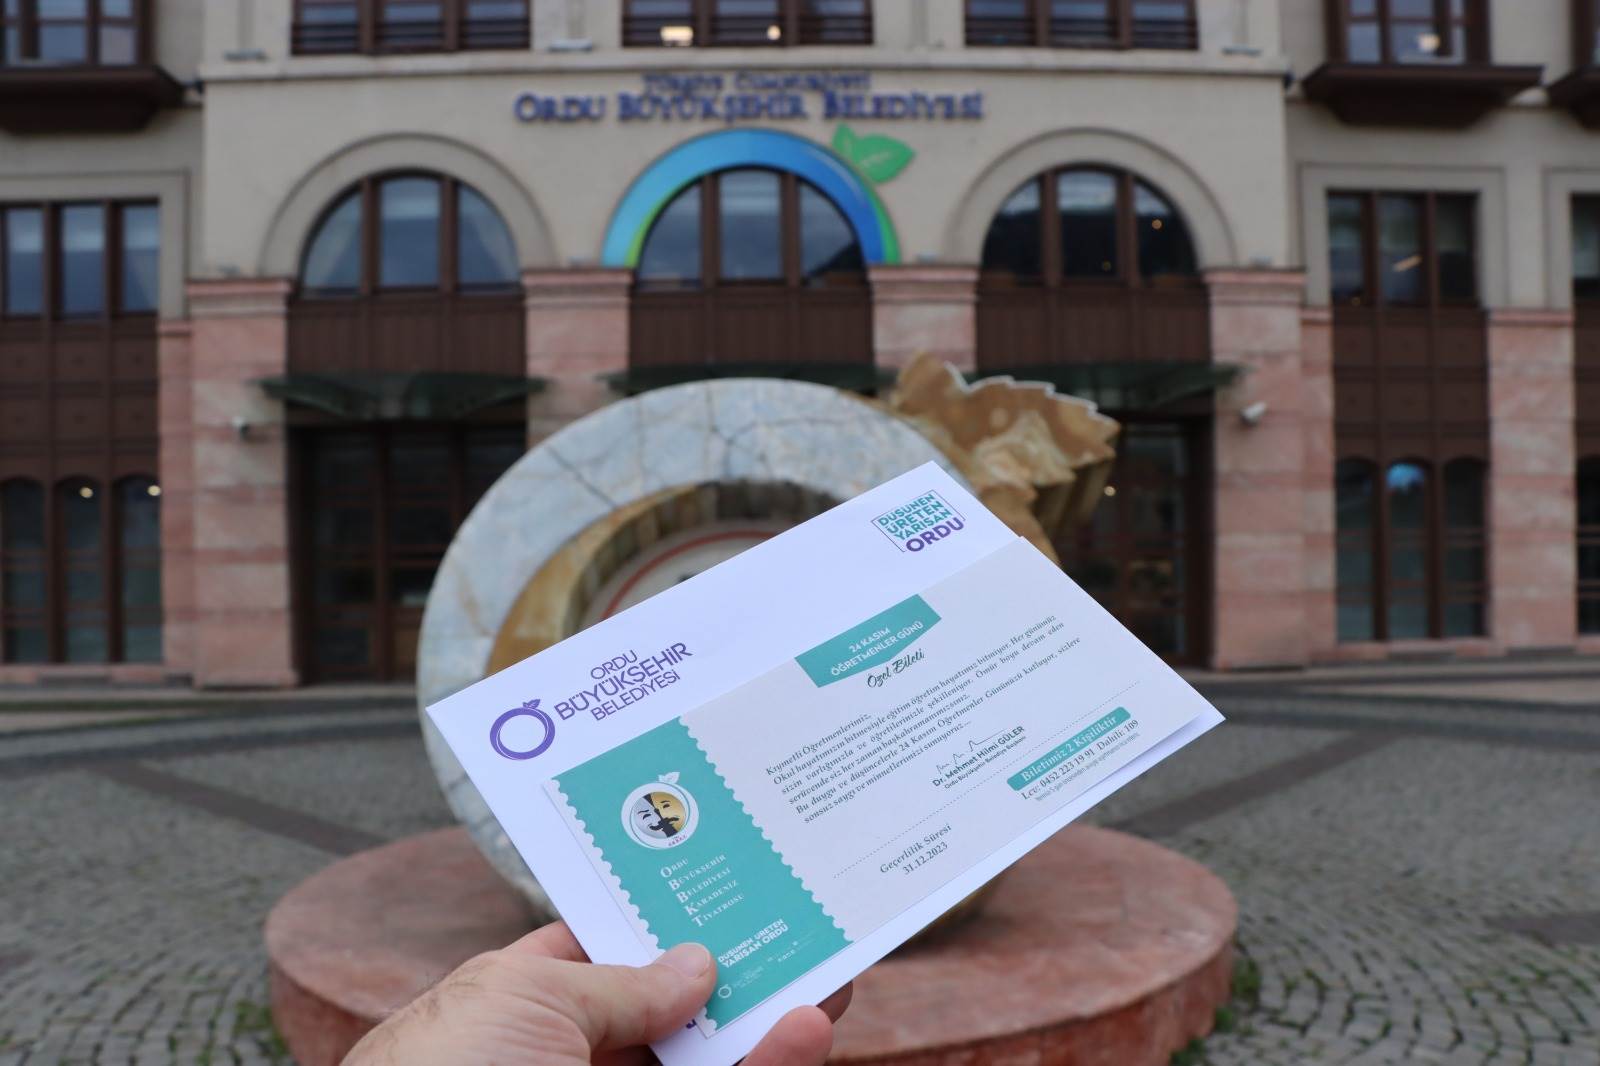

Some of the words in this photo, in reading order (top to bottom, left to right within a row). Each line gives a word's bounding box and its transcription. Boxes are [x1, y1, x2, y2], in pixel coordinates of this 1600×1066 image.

[514, 92, 605, 122] ORDU
[906, 518, 964, 552] ORDU
[831, 636, 898, 675] ÖĞRETMENLER
[897, 621, 923, 639] GÜNÜ
[849, 643, 862, 652] 24
[861, 628, 890, 646] KASIM
[554, 643, 693, 720] BÜYÜKŞEHİR
[591, 650, 637, 679] ORDU
[868, 667, 891, 687] Özel
[892, 648, 924, 673] Bileti
[590, 669, 680, 720] BELEDİYESİ
[774, 768, 795, 784] Okul
[887, 703, 910, 719] eğitim
[911, 685, 940, 704] öğretim
[1010, 634, 1024, 645] Her
[782, 780, 802, 794] sizin
[857, 742, 866, 750] ve
[976, 663, 997, 678] Ömür
[1000, 651, 1019, 663] boyu
[1022, 634, 1045, 651] devam
[1048, 623, 1064, 635] eden
[796, 804, 809, 814] Bu
[812, 787, 836, 805] duygu
[838, 780, 848, 788] ve
[899, 742, 910, 751] 24
[910, 727, 936, 744] Kasım
[938, 697, 983, 727] Öğretmenler
[841, 762, 854, 773] her
[856, 746, 882, 764] zaman
[932, 778, 946, 786] Dr.
[945, 757, 978, 778] Mehmet
[976, 743, 998, 758] Hilmi
[998, 726, 1024, 744] GÜLER
[1021, 749, 1070, 781] Biletimiz
[1066, 744, 1074, 752] 2
[1073, 717, 1116, 747] Kişiliktir
[1040, 772, 1060, 787] 0452
[1059, 762, 1074, 775] 223
[1074, 755, 1084, 764] 19
[1124, 720, 1138, 732] 109
[855, 782, 868, 791] ve
[880, 842, 924, 872] Geçerlilik
[924, 824, 951, 845] Süresi
[903, 842, 947, 874] 31.12.2023
[760, 924, 788, 943] ORDU
